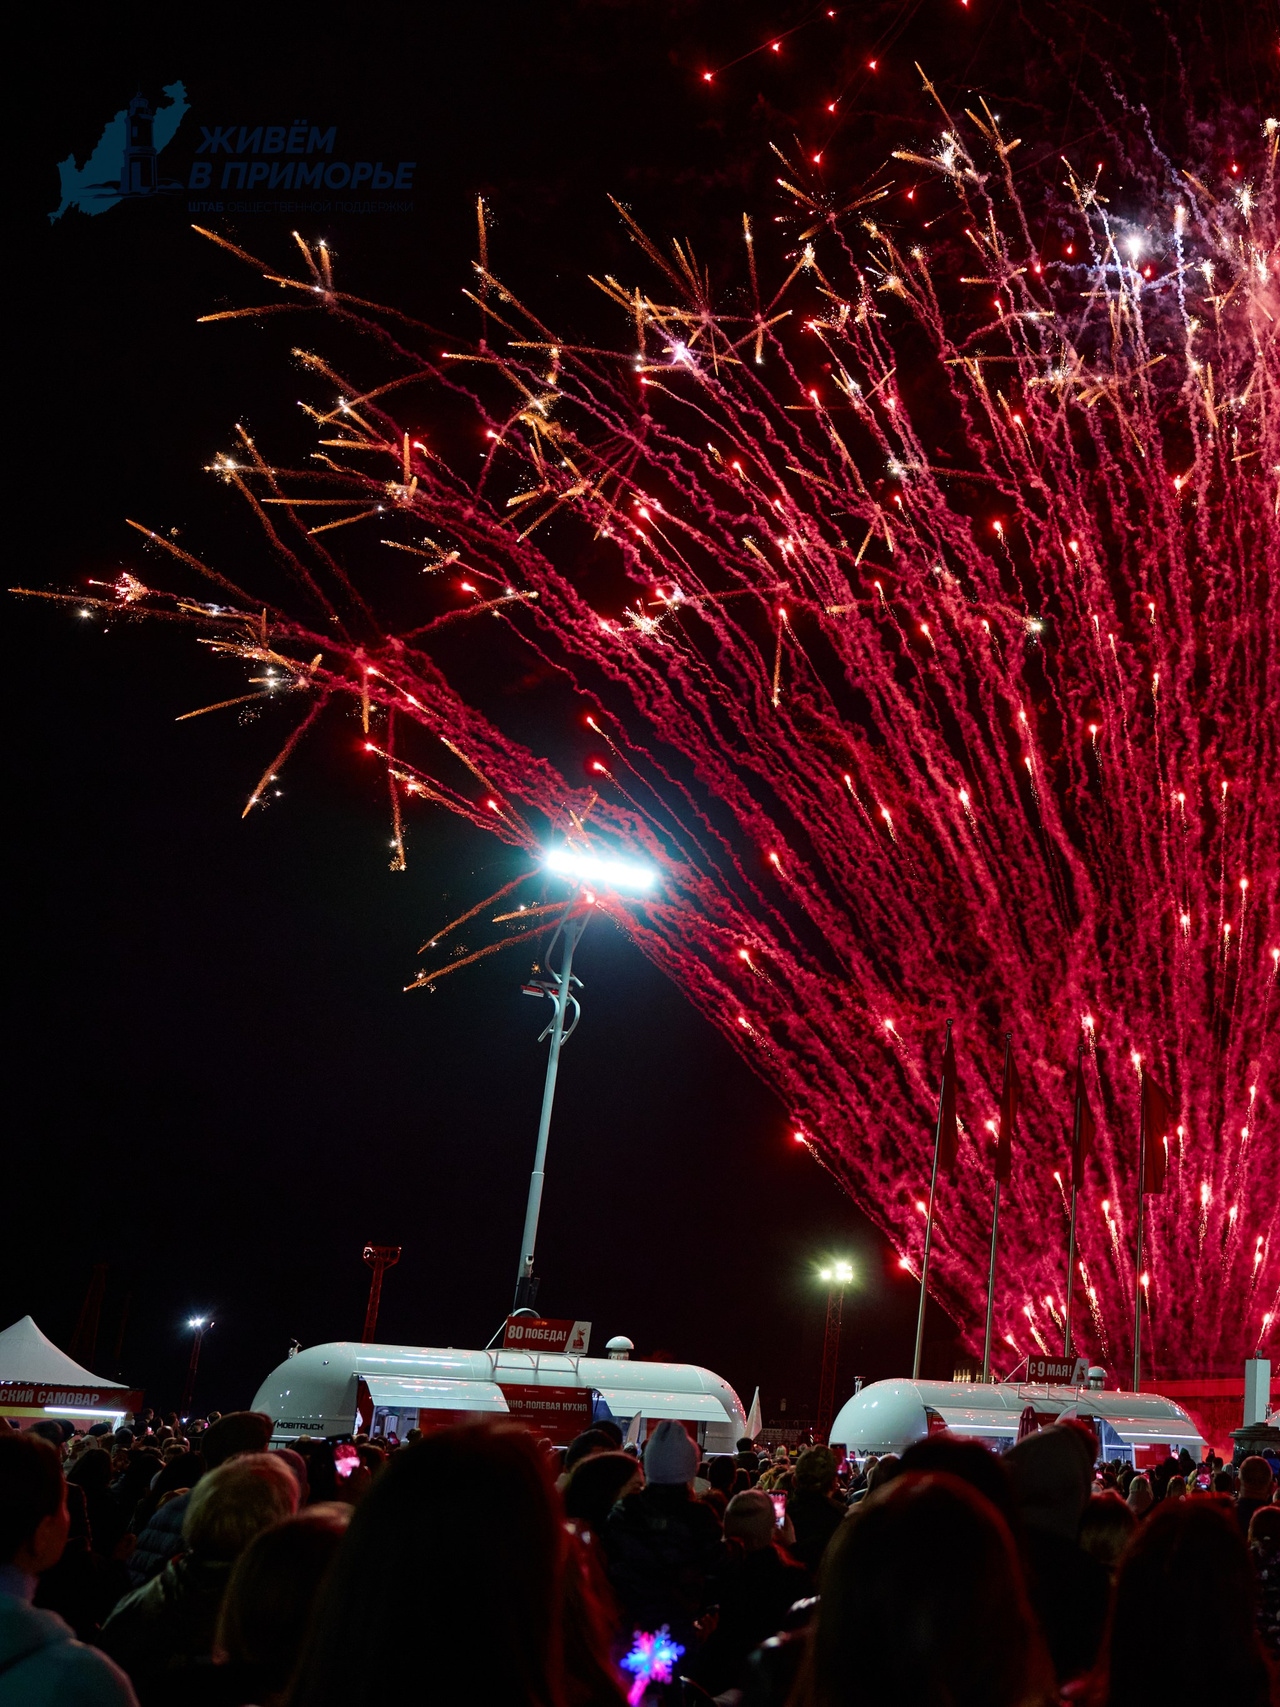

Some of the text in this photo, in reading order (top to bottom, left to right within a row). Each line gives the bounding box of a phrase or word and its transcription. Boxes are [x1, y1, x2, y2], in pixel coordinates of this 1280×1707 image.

[507, 1325, 567, 1342] 80 ПОБЕДА!
[1029, 1361, 1072, 1377] С 9 МАЯ!
[37, 1391, 100, 1406] САМОВАР
[562, 1402, 588, 1413] КУХНЯ
[276, 1421, 324, 1430] MOBITRUCK
